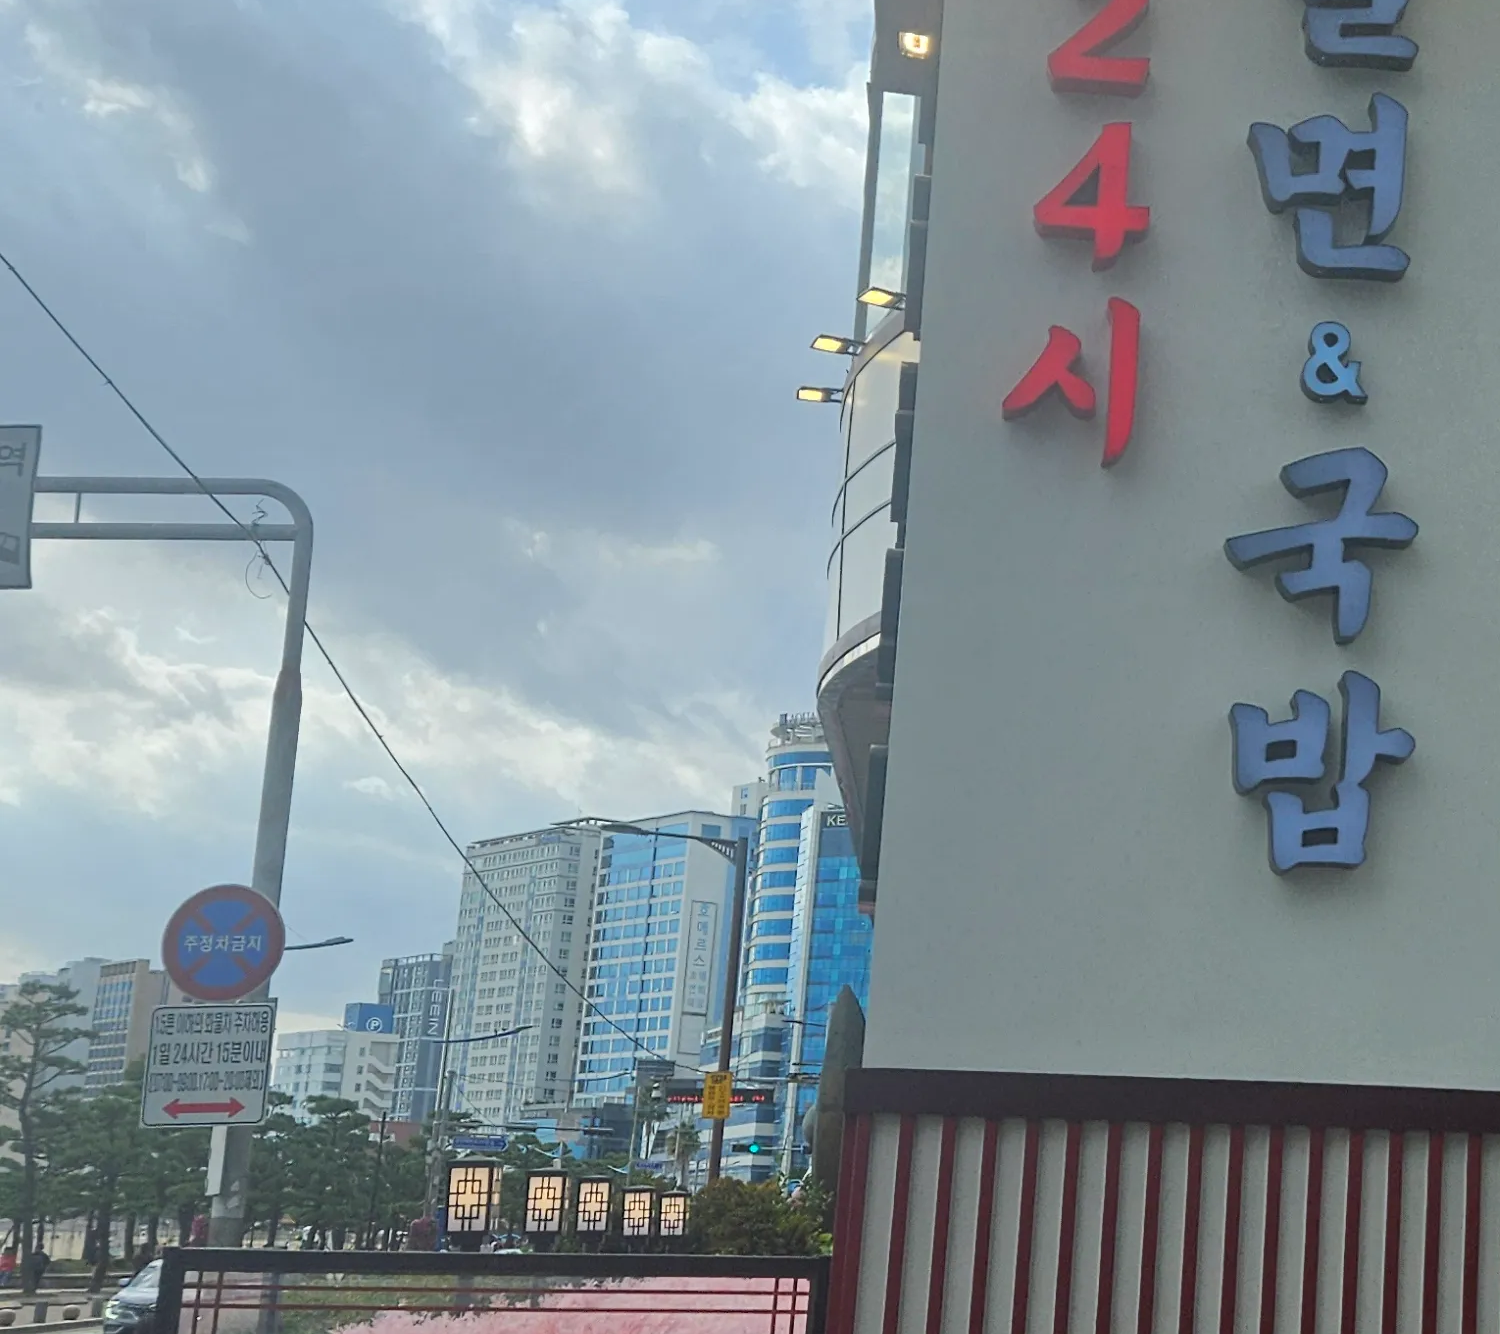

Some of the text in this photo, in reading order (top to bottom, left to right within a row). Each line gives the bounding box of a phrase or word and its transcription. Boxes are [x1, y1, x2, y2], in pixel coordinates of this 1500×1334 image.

[1300, 320, 1369, 406] &
[1223, 446, 1420, 877] 국밥
[183, 934, 262, 953] 주정차금지
[152, 1043, 171, 1066] 1일
[173, 1041, 213, 1065] 24시간
